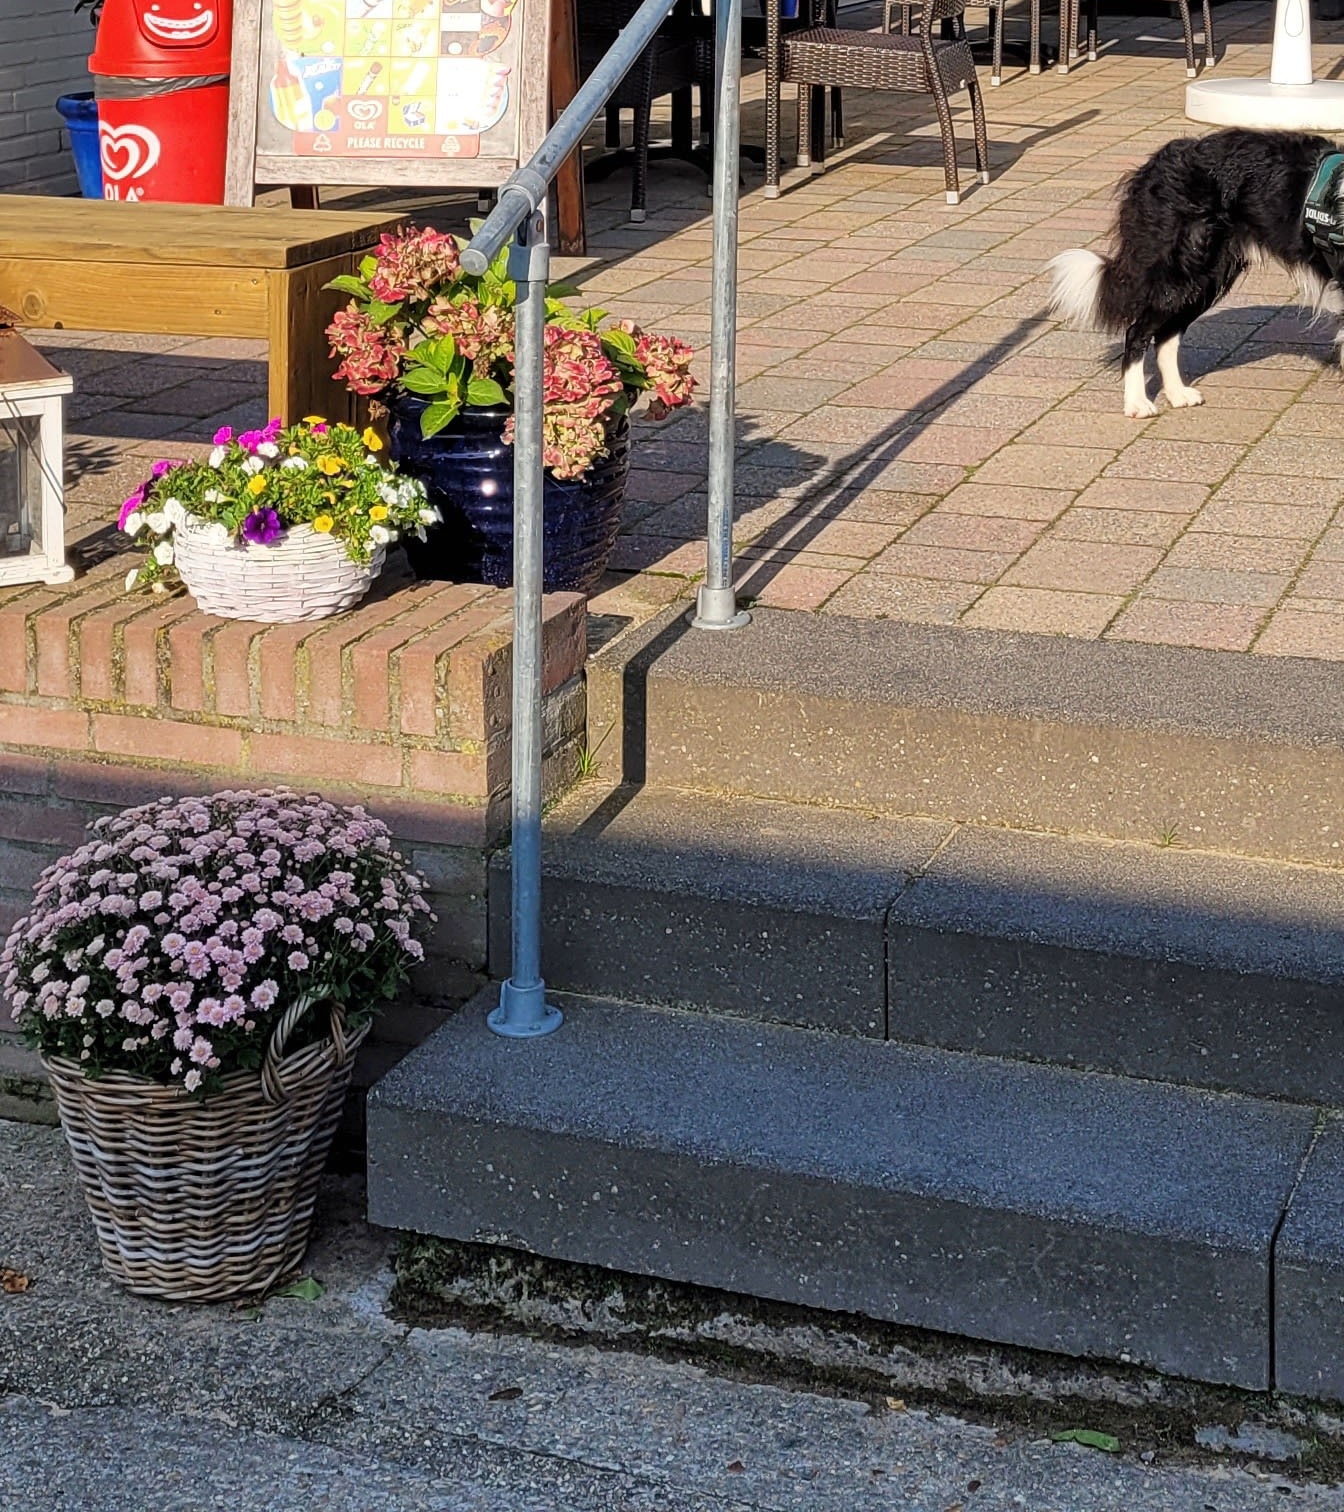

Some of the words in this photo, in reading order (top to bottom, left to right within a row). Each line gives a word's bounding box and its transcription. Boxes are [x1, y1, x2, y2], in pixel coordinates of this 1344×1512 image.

[353, 121, 376, 130] OLA
[347, 137, 381, 149] PLEASE
[384, 137, 425, 149] RECYCLE
[1305, 207, 1337, 226] JULIUS-
